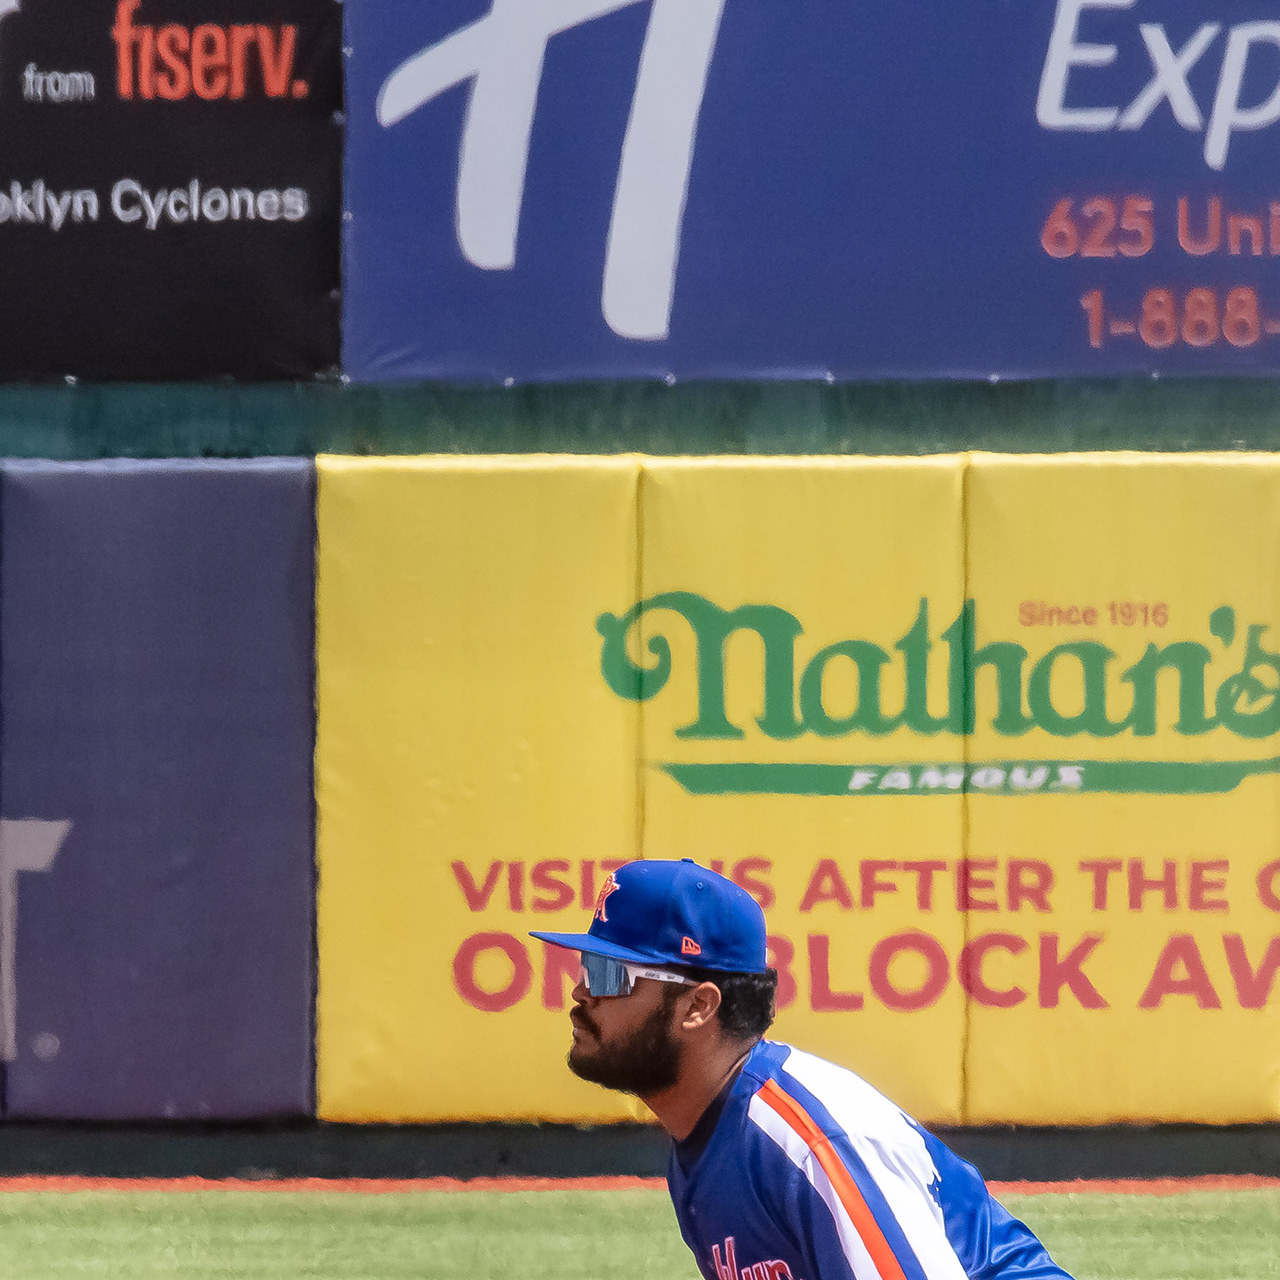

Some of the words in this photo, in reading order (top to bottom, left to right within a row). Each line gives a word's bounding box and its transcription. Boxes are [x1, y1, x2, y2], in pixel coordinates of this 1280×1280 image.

[22, 62, 96, 102] from
[111, 177, 310, 230] Cyclones
[1040, 195, 1154, 258] 625
[1018, 600, 1098, 629] Since
[1107, 600, 1170, 629] 1916
[847, 762, 1087, 793] FAMOUS
[709, 857, 776, 912] S
[799, 856, 1055, 914] AFTER
[1078, 856, 1230, 913] THE
[452, 930, 583, 1014] ON
